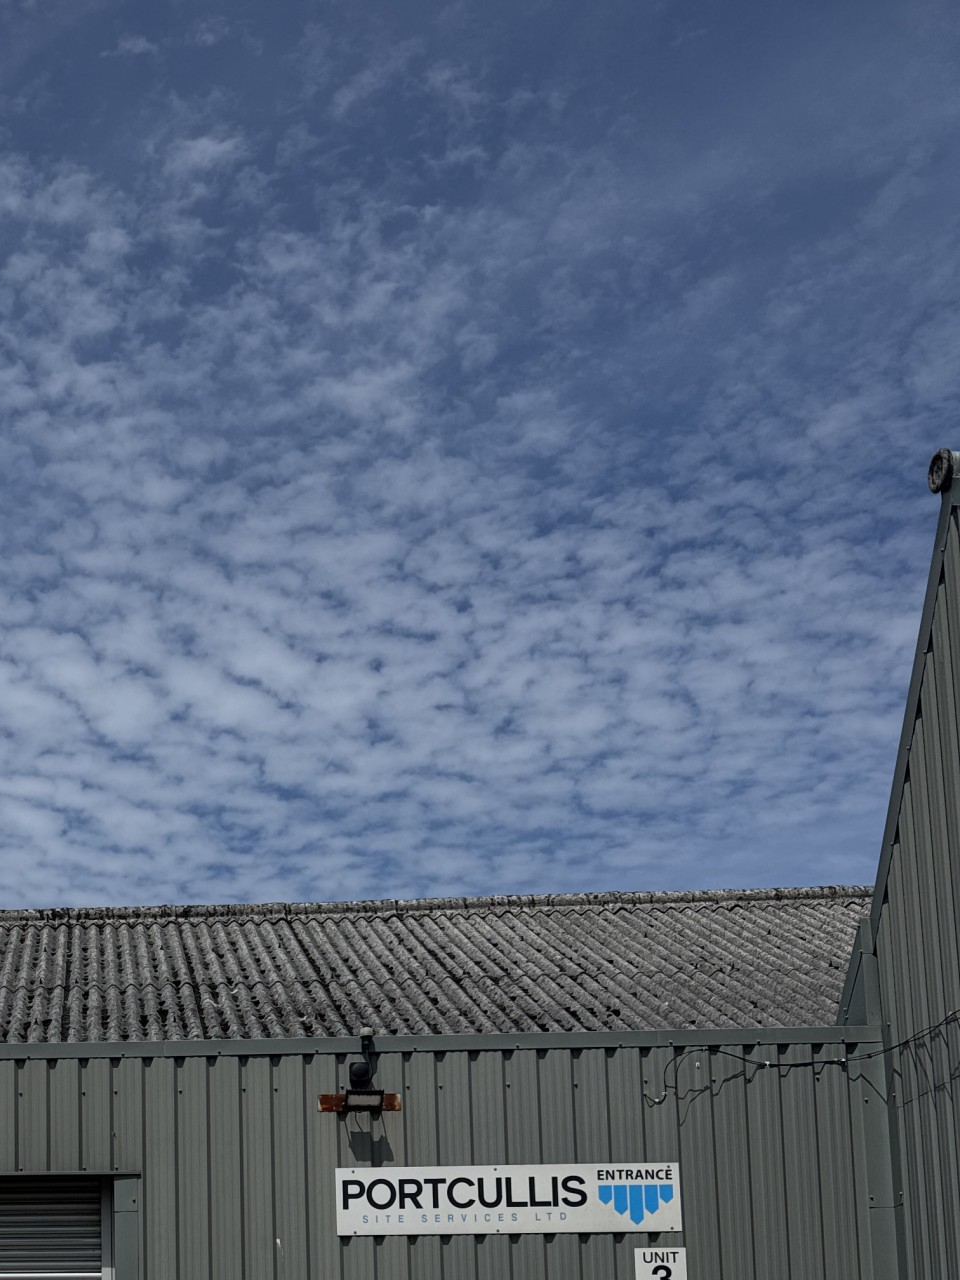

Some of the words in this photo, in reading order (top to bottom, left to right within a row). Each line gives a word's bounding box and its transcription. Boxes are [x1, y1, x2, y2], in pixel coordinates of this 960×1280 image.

[597, 1169, 673, 1181] ENTRANCE
[342, 1175, 588, 1210] PORTCULLIS
[362, 1214, 405, 1224] SITE
[421, 1213, 519, 1223] SERVICES
[535, 1212, 568, 1222] LTD
[642, 1251, 679, 1264] UNIT
